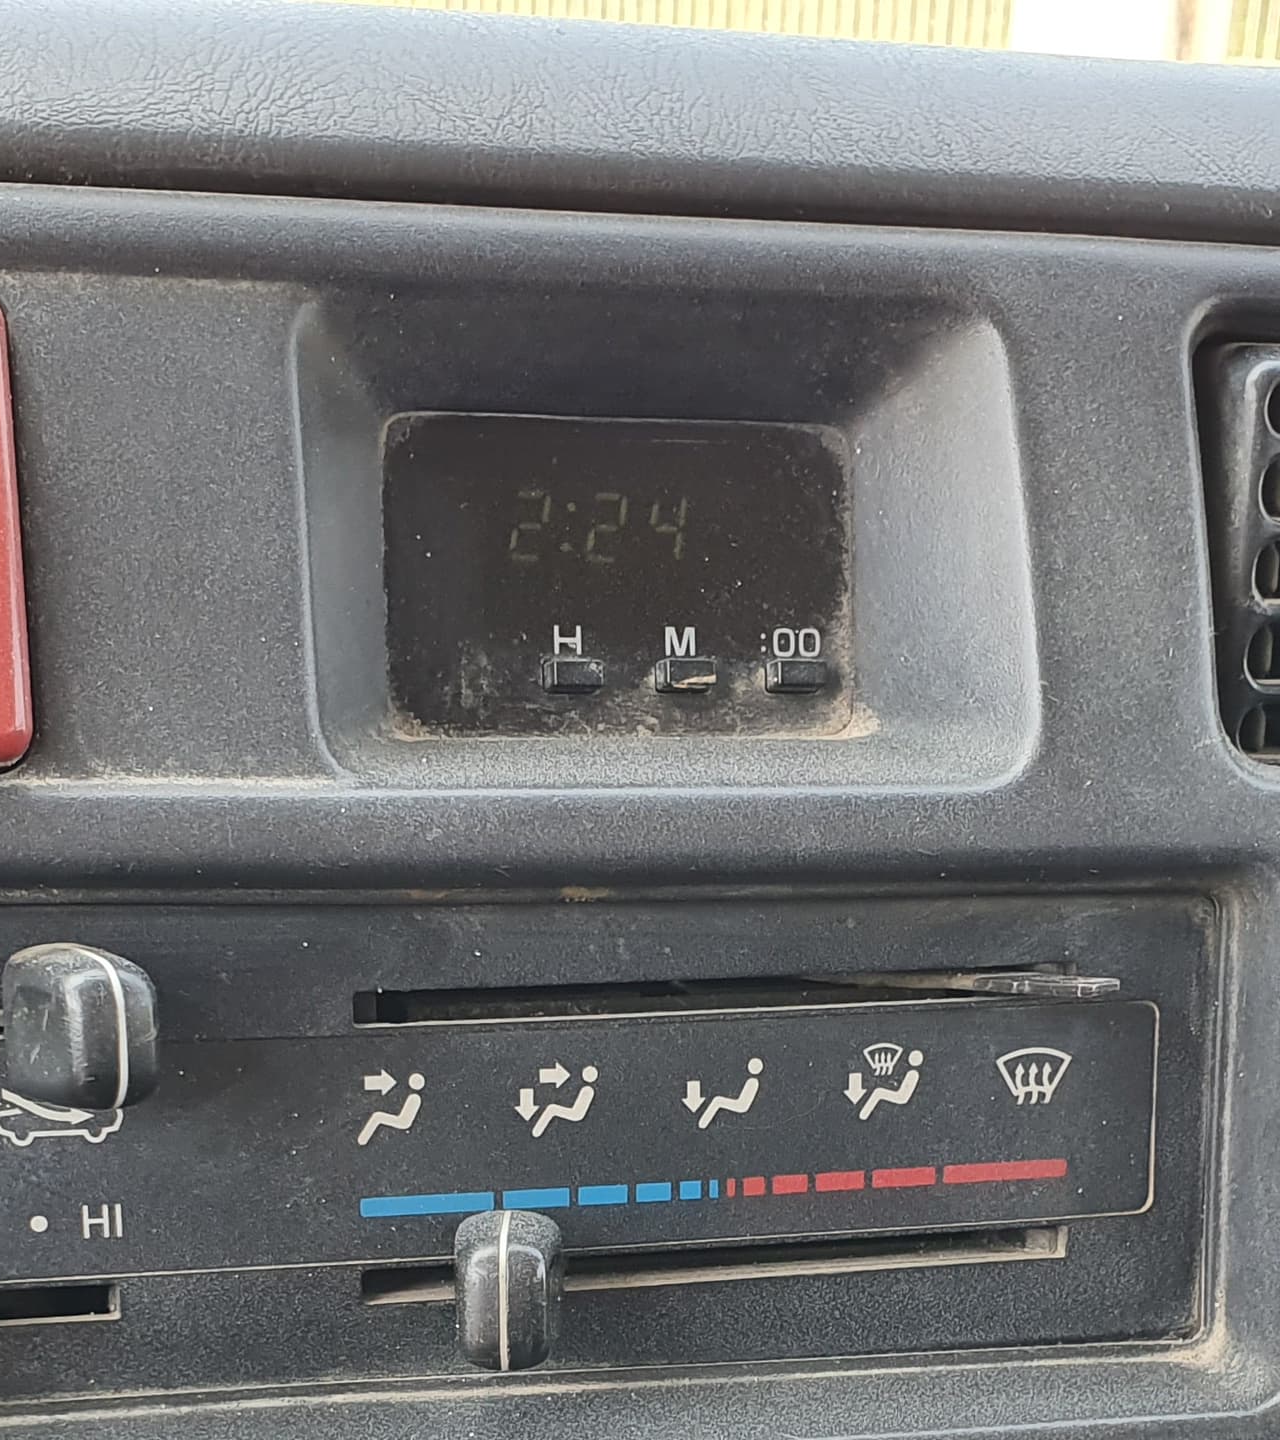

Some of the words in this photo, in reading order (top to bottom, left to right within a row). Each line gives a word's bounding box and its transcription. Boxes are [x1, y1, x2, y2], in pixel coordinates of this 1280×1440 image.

[553, 624, 582, 655] H
[664, 626, 697, 657] M
[82, 1204, 124, 1239] HI
